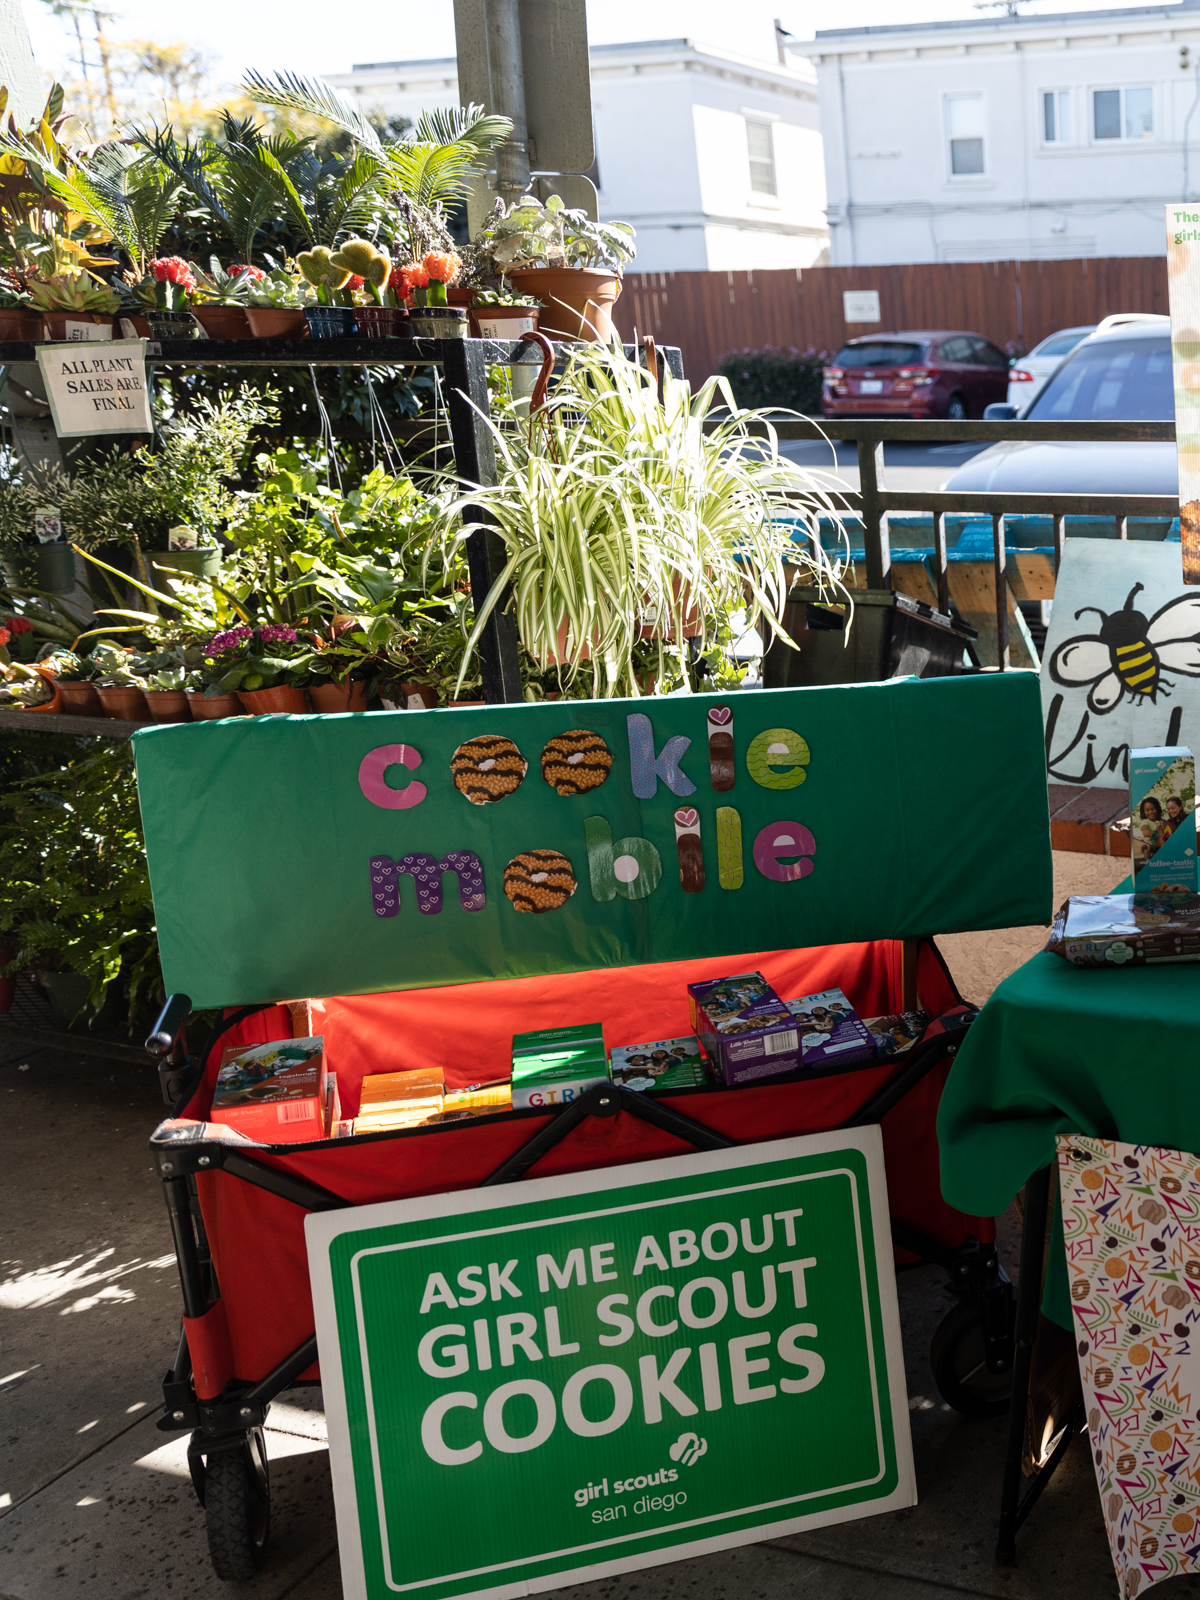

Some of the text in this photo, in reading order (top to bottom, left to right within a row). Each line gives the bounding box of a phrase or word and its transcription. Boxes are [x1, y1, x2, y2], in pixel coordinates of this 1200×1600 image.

[1174, 211, 1199, 223] The
[61, 358, 134, 375] ALL PLANT
[66, 377, 142, 394] SALES ARE
[92, 397, 135, 411] FINAL
[358, 704, 811, 811] cookie
[368, 806, 817, 919] mobile
[419, 1208, 804, 1314] ASK ME ABOUT
[418, 1257, 817, 1379] GIRL SCOUT
[420, 1322, 825, 1467] COOKIES
[574, 1467, 678, 1508] girl scouts
[591, 1490, 687, 1524] san diego
